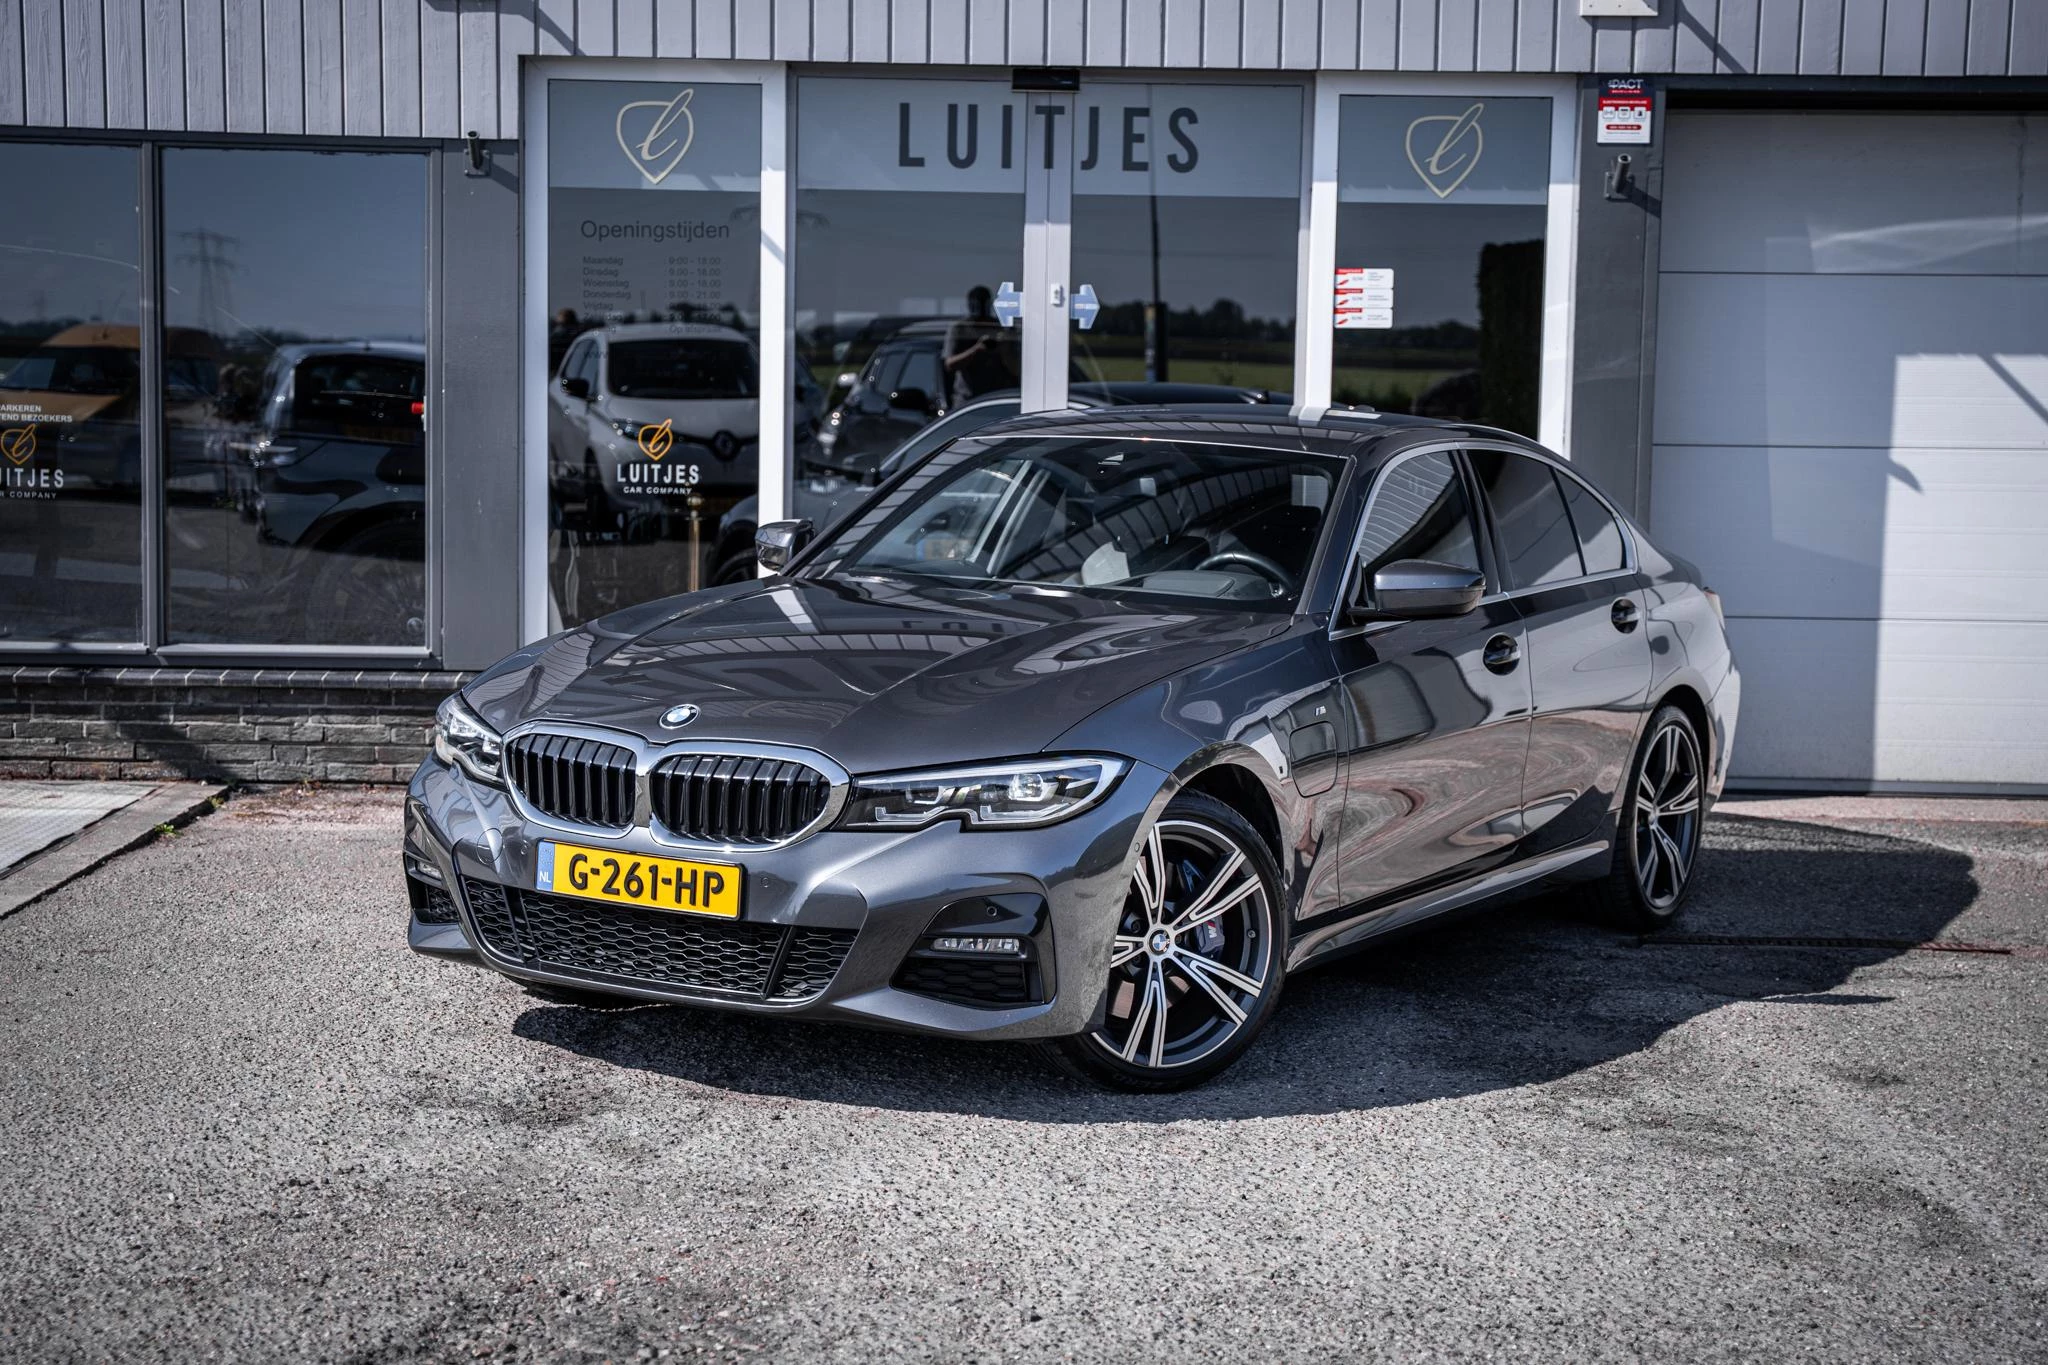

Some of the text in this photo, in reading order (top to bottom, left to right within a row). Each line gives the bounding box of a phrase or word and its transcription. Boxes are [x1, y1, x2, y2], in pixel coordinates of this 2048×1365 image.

[898, 102, 1199, 173] LUITJES
[581, 220, 729, 242] Openingstijden
[583, 267, 619, 277] Dinsdag
[0, 413, 73, 422] END BEZOEKERS
[0, 467, 64, 488] ITJES
[617, 463, 699, 484] LUITJES
[9, 490, 57, 499] COMPANY
[623, 486, 692, 495] CAR COMPANY
[539, 872, 552, 884] NL
[568, 853, 725, 908] G-261-HP
